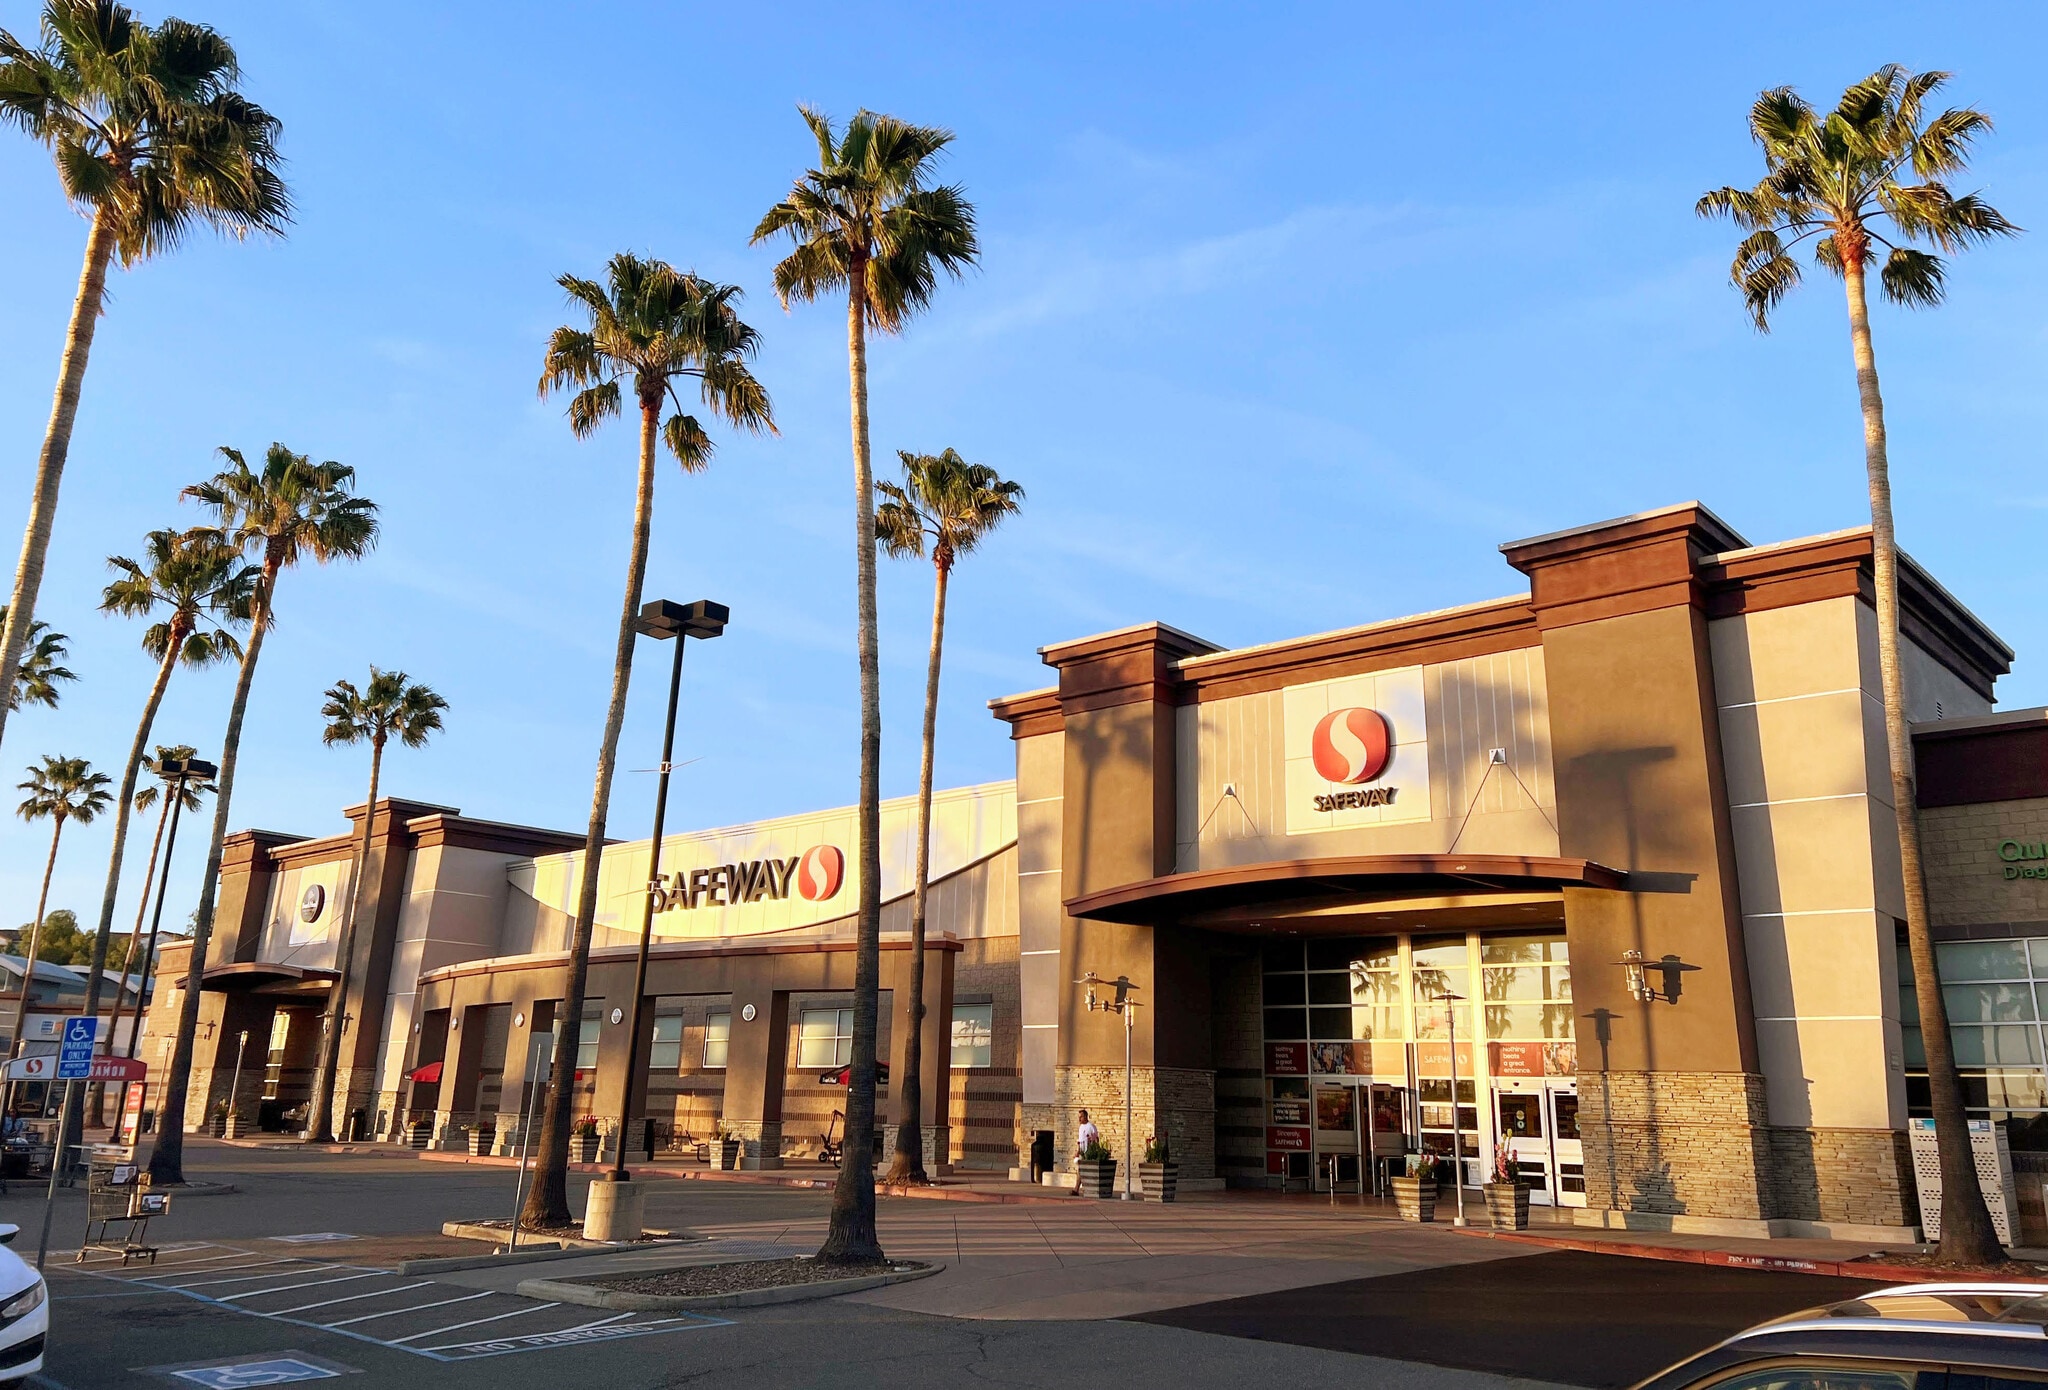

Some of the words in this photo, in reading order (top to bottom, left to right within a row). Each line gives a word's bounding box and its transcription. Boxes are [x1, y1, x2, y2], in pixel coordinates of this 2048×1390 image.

[1313, 787, 1395, 812] SAFEWAY
[1996, 838, 2048, 861] Qu
[652, 856, 800, 913] SAFEWAY
[64, 1041, 93, 1050] PARKING
[1503, 1046, 1525, 1054] Nothing
[68, 1051, 86, 1060] ONLY
[1424, 1055, 1452, 1064] SAFEW
[1746, 1257, 1765, 1266] LANE
[1786, 1260, 1816, 1269] PARKING
[465, 1342, 516, 1353] NO
[521, 1325, 654, 1345] PARKING
